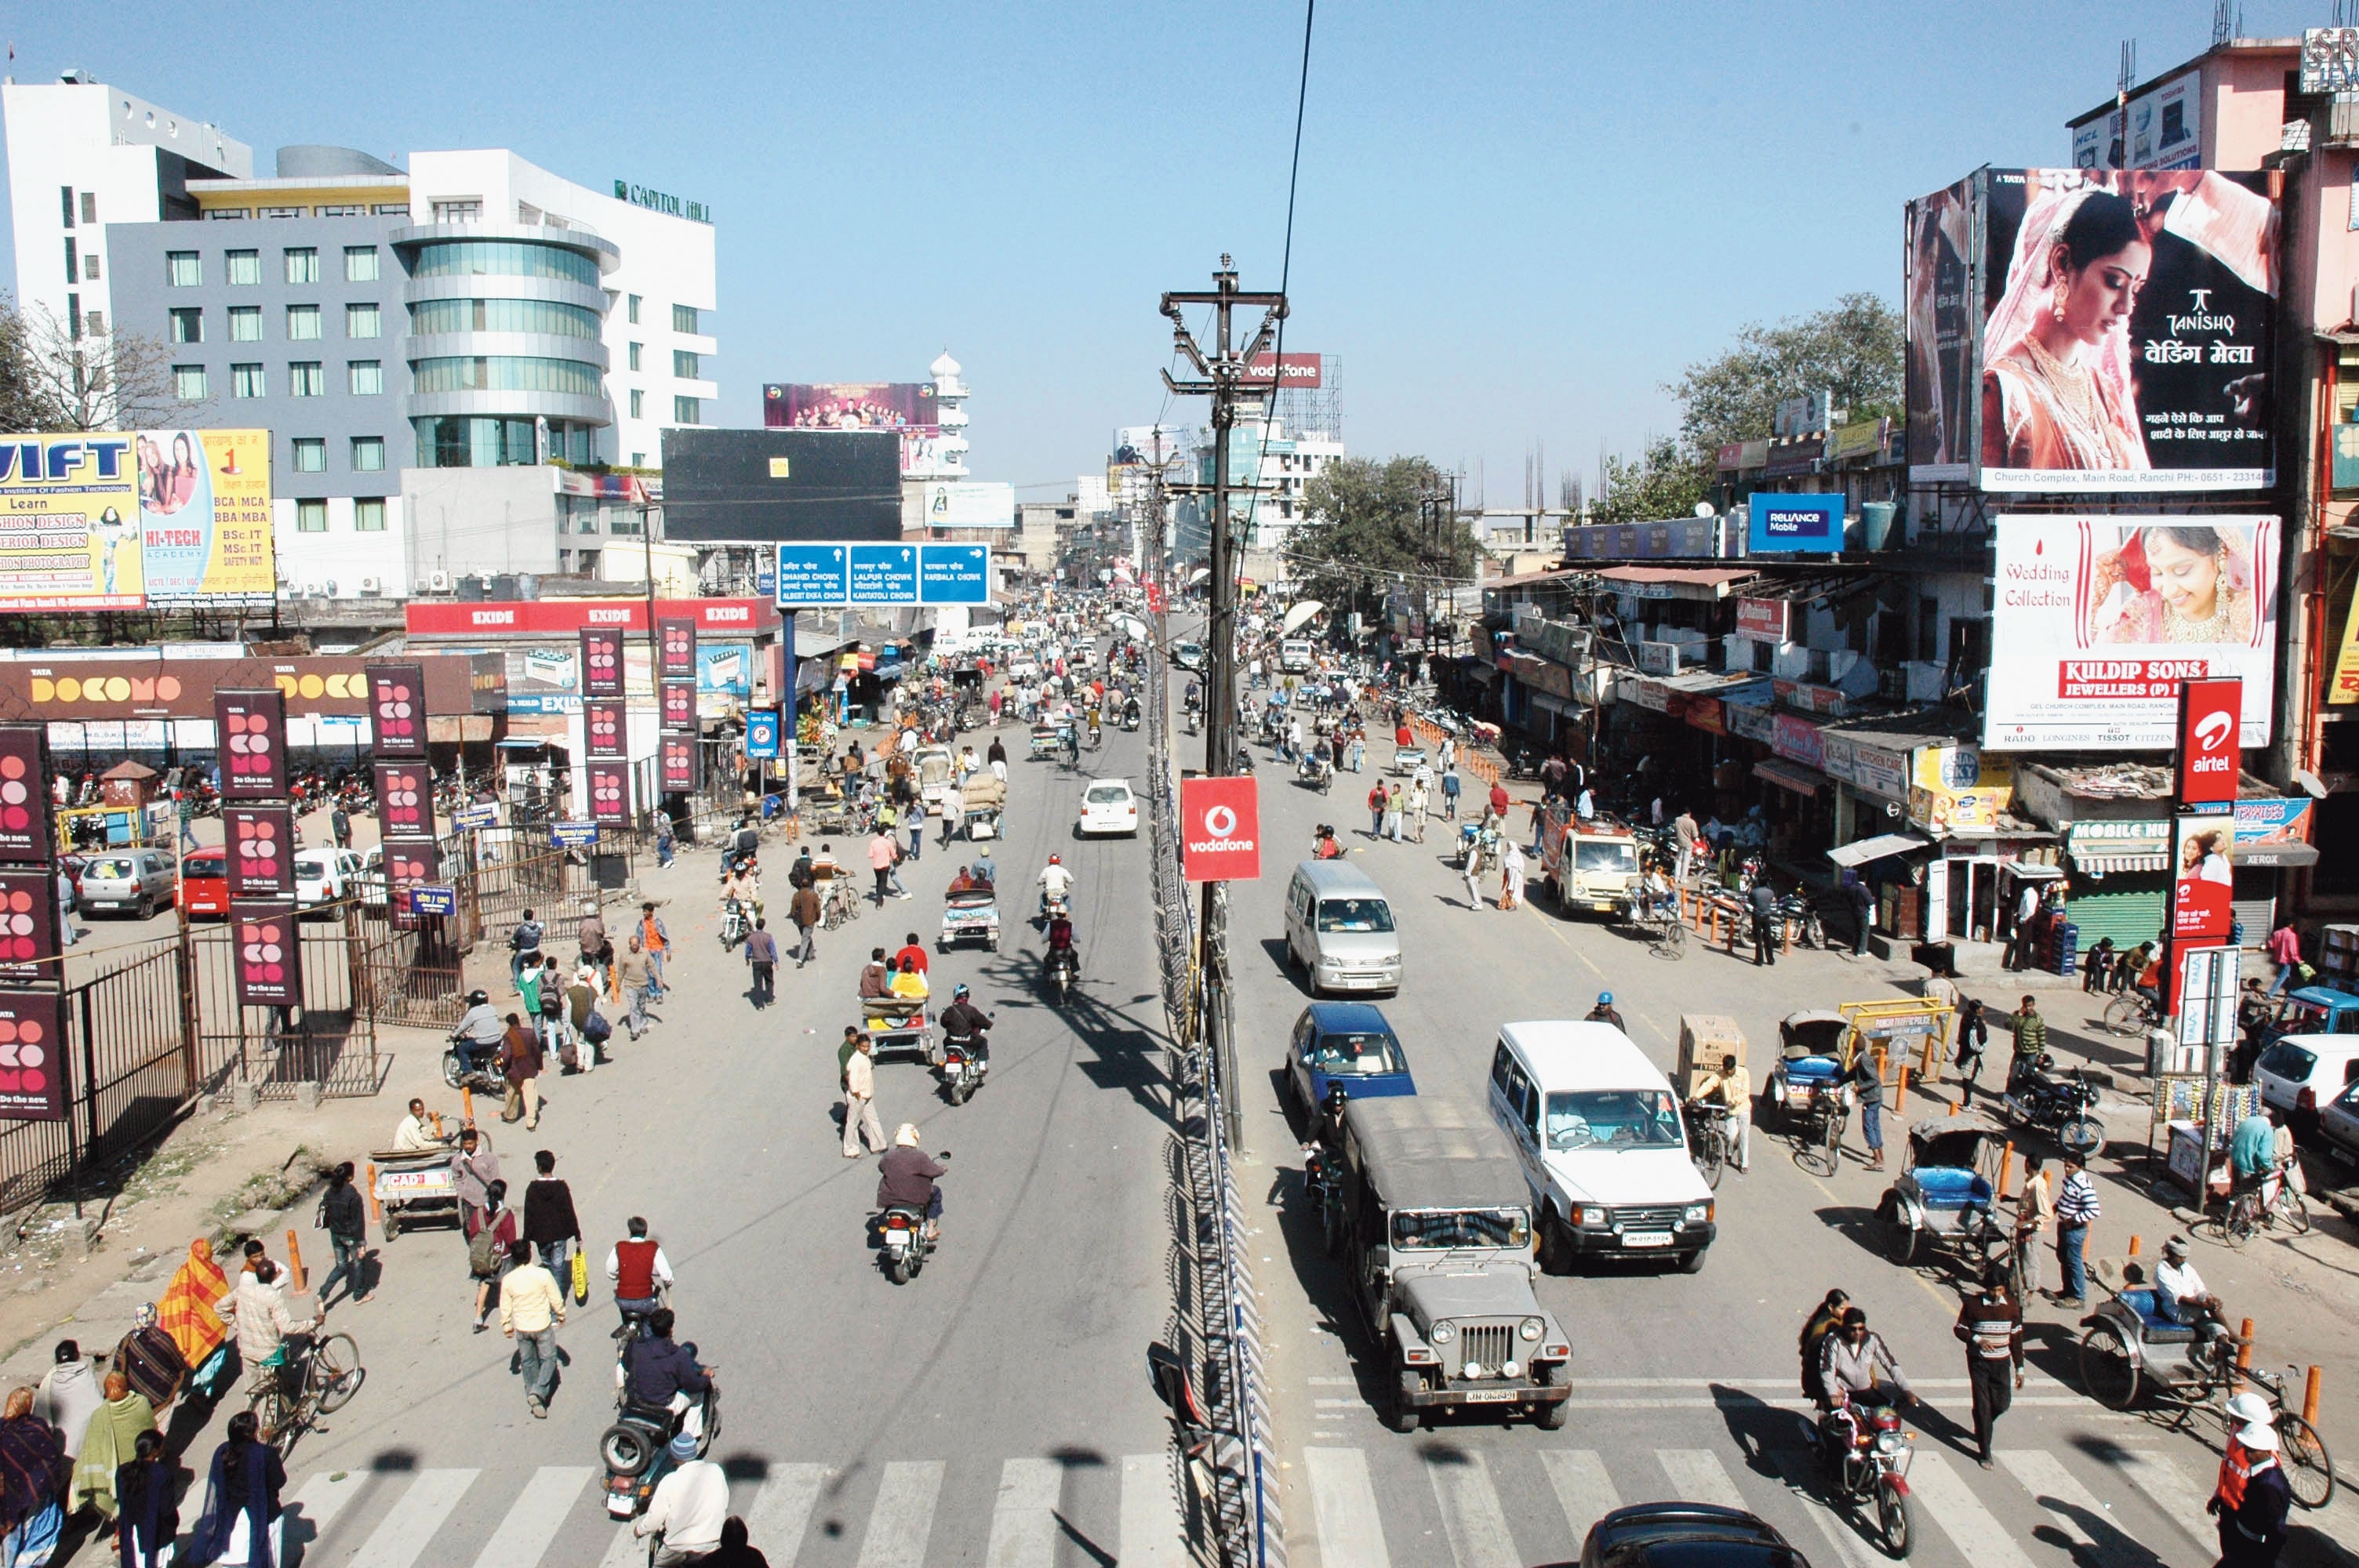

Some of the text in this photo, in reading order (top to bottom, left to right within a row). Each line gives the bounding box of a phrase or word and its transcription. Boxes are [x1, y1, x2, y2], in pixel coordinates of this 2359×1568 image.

[2076, 130, 2098, 146] HCL
[2159, 144, 2197, 165] SOLUTIONS
[2003, 175, 2025, 183] TATA
[631, 184, 714, 224] CAPITOL HILL
[2145, 339, 2255, 364] वेडिंग मेला
[1249, 363, 1316, 378] vodfone
[2146, 412, 2224, 423] गहने ऐसे कि आप
[2150, 428, 2172, 440] शादी
[2174, 428, 2186, 440] के
[2187, 428, 2205, 440] लिए
[2234, 428, 2245, 440] हो
[225, 448, 234, 470] 1
[1994, 472, 2030, 482] Church
[2034, 472, 2079, 484] Complex,
[2083, 473, 2106, 482] Main
[2109, 472, 2137, 484] Road,
[2139, 472, 2174, 482] Ranchi
[2201, 472, 2223, 482] 0651
[10, 499, 48, 509] Learn
[214, 497, 264, 506] BCA MCA
[37, 514, 85, 528] DESIGN
[215, 512, 267, 522] BBA MBA
[1770, 522, 1797, 532] Mobile
[42, 534, 87, 547] DESIGN
[146, 529, 202, 546] HI-TECH
[23, 554, 89, 569] PHOTOGRAPHY
[2006, 564, 2070, 583] Wedding
[2005, 590, 2070, 608] Collection
[472, 611, 514, 624] EXIDE
[589, 609, 631, 622] EXIDE
[706, 607, 748, 621] EXIDE
[2066, 662, 2201, 683] KULDIP SONS
[31, 676, 181, 702] DOCOMO
[275, 673, 369, 699] DOCO
[378, 685, 410, 702] DO
[2066, 683, 2170, 697] JEWELLERS (P)
[379, 702, 412, 718] CO
[541, 696, 583, 711] EXID
[228, 714, 268, 733] DO
[230, 735, 270, 753] CO
[231, 754, 271, 773] MO
[1886, 756, 1903, 771] CARE
[2193, 756, 2230, 773] airtel
[1944, 766, 1976, 778] SKY
[387, 775, 416, 790] DO
[387, 791, 417, 807] CO
[2235, 804, 2285, 820] TERPRISES
[238, 822, 274, 839] DO
[2073, 823, 2170, 839] MOBILE HU
[239, 840, 276, 857] CO
[1189, 838, 1253, 853] vodafone
[241, 858, 277, 876] MO
[2247, 855, 2278, 864] XEROX
[394, 862, 425, 877] DO
[242, 924, 281, 942] DO
[244, 944, 282, 962] CO
[245, 964, 283, 982] MO
